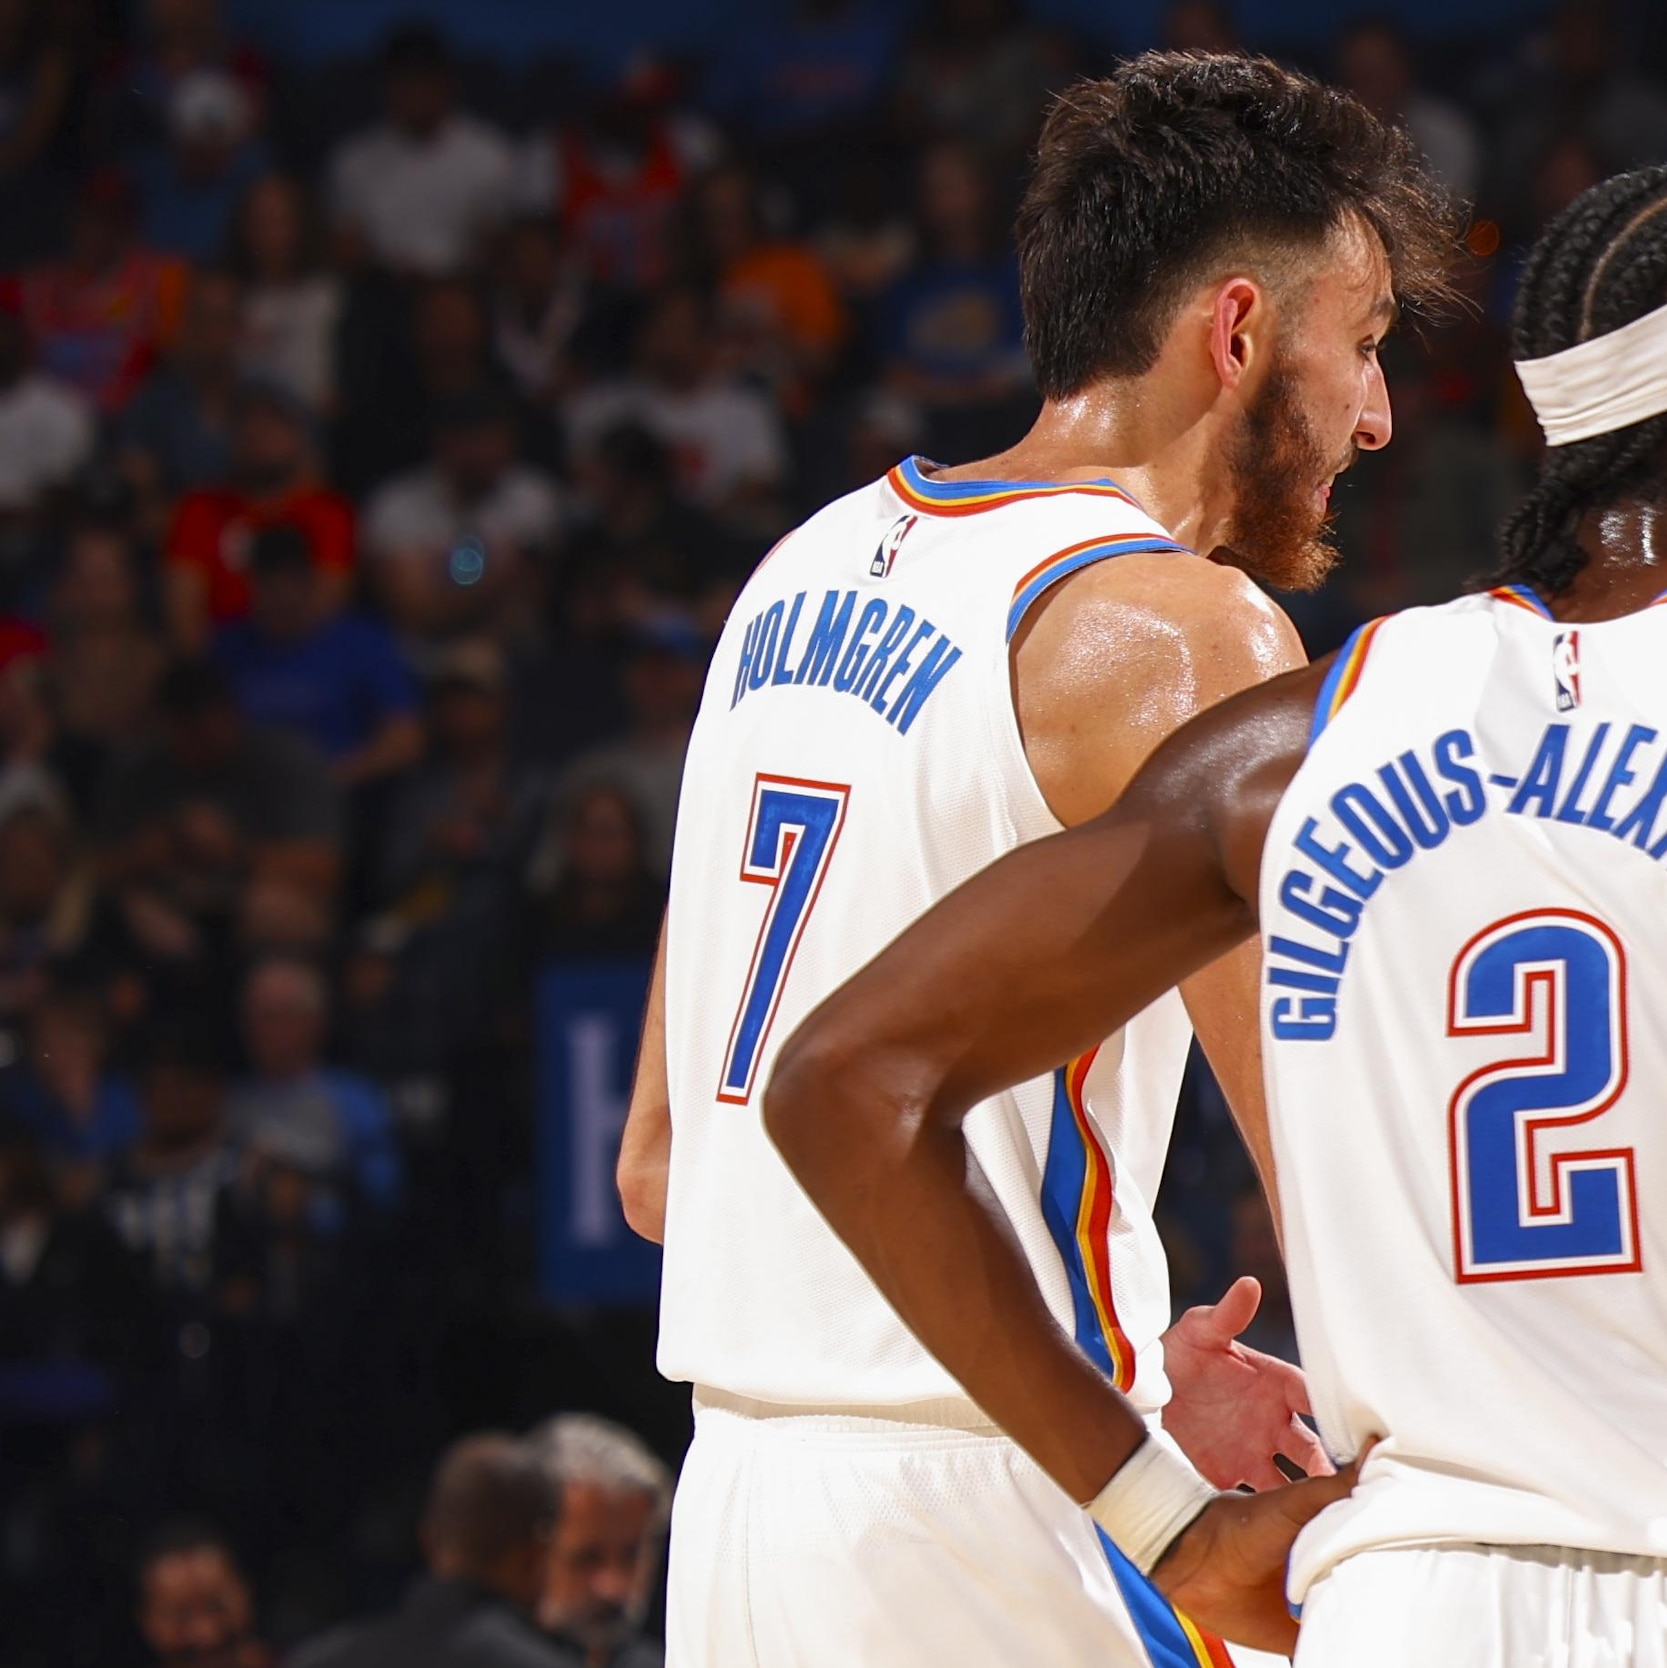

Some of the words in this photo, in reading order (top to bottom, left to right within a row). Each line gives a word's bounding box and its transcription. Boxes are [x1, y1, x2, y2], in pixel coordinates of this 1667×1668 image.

[731, 590, 962, 736] HOLMGREN
[717, 773, 851, 1105] 7
[1447, 907, 1643, 1285] 2
